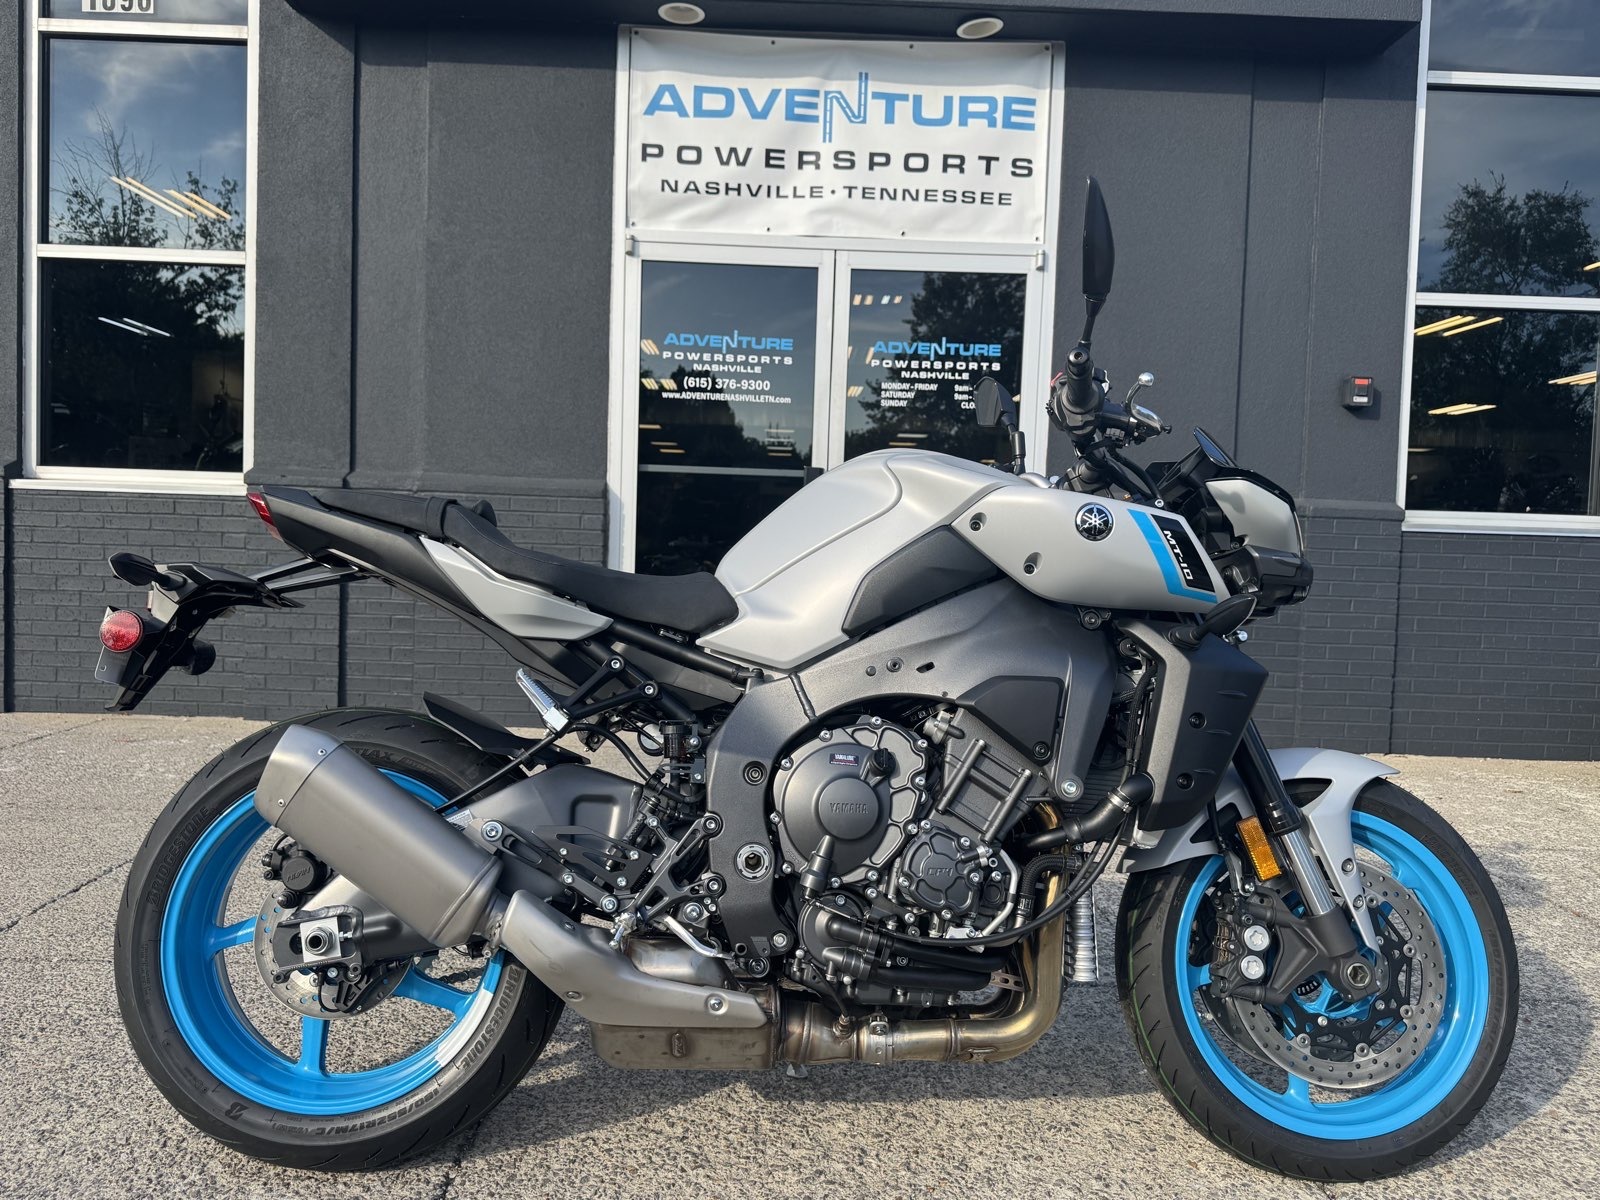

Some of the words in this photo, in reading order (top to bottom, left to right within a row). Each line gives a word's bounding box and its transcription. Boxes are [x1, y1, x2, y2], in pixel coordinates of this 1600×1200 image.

[642, 71, 1037, 143] ADVENTURE
[641, 143, 1034, 178] POWERSPORTS
[660, 178, 824, 199] NASHVILLE
[843, 185, 1013, 206] TENNESSEE
[664, 330, 793, 354] ADVENTURE
[873, 337, 1002, 360] ADVENTURE
[662, 351, 793, 365] POWERSPORTS
[871, 359, 1001, 371] POWERSPORTS
[693, 363, 762, 374] NASHVILLE
[901, 371, 970, 380] NASHVILLE
[683, 376, 712, 390] (615)
[715, 379, 771, 391] 376-9300
[662, 391, 792, 404] www.ADVENTURENASHVILLETN.com
[880, 391, 916, 399] SATURDAY
[1163, 530, 1194, 581] MT-10
[829, 802, 869, 814] YAMAHA
[149, 806, 211, 907] BRIDGESTONE
[460, 965, 521, 1071] BRIDGESTONE
